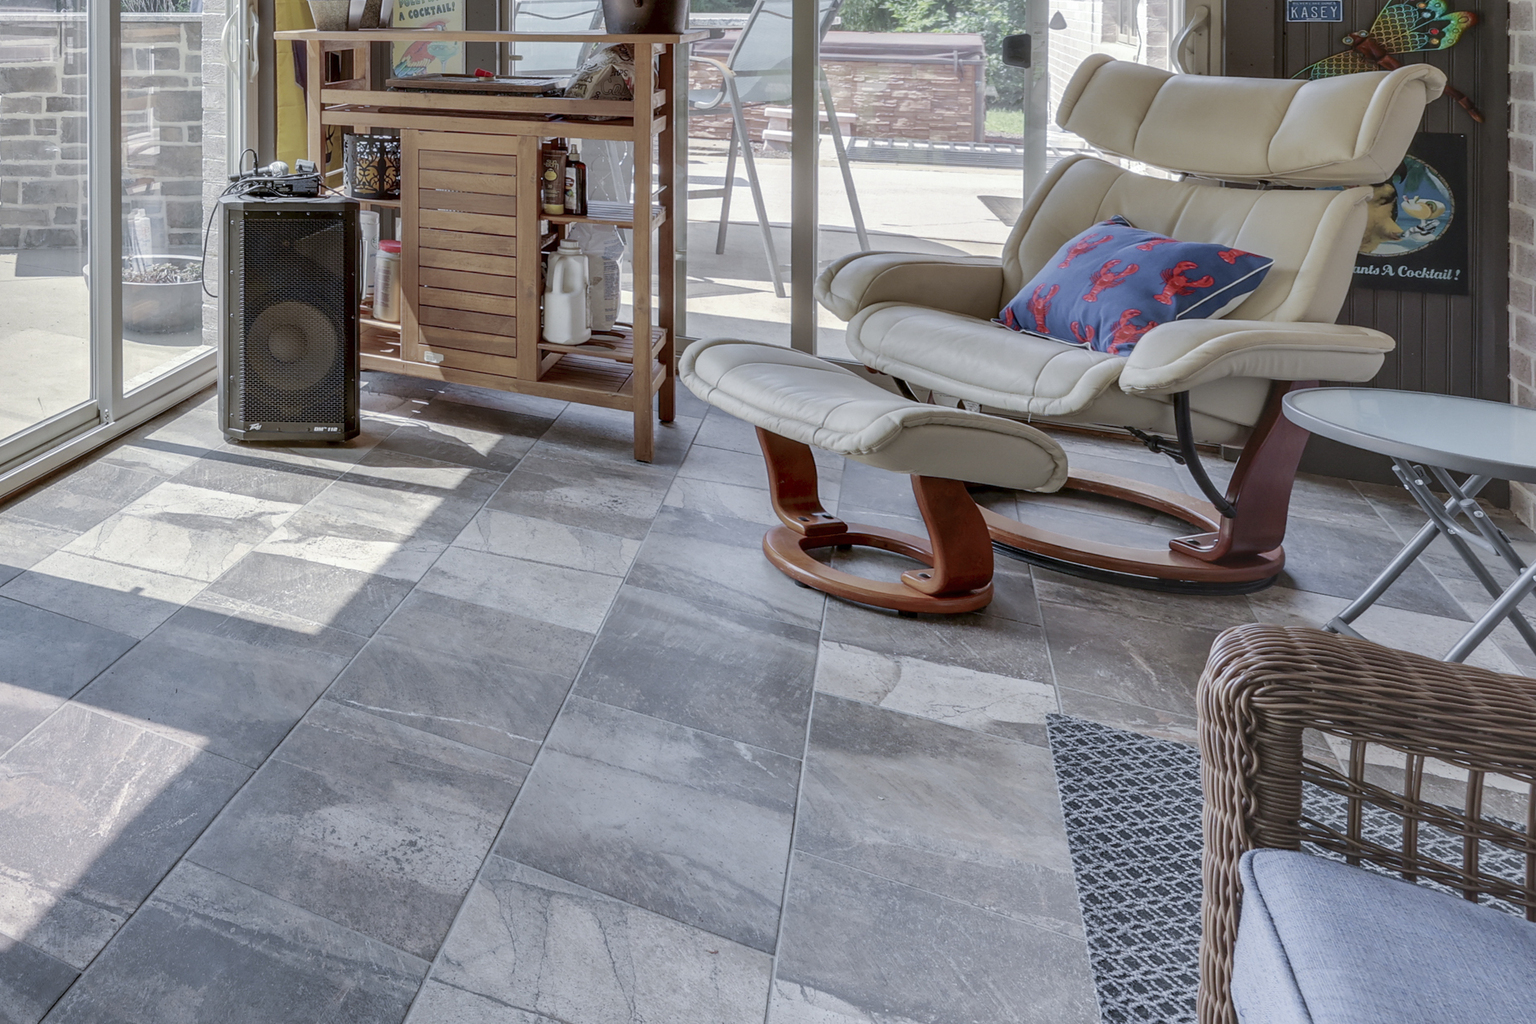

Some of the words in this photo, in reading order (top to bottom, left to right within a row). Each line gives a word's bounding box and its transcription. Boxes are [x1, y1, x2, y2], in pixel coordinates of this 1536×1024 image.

[408, 1, 456, 19] COCKTAIL!
[1290, 6, 1338, 19] KASEY
[1352, 264, 1380, 276] ants
[1381, 264, 1395, 277] A
